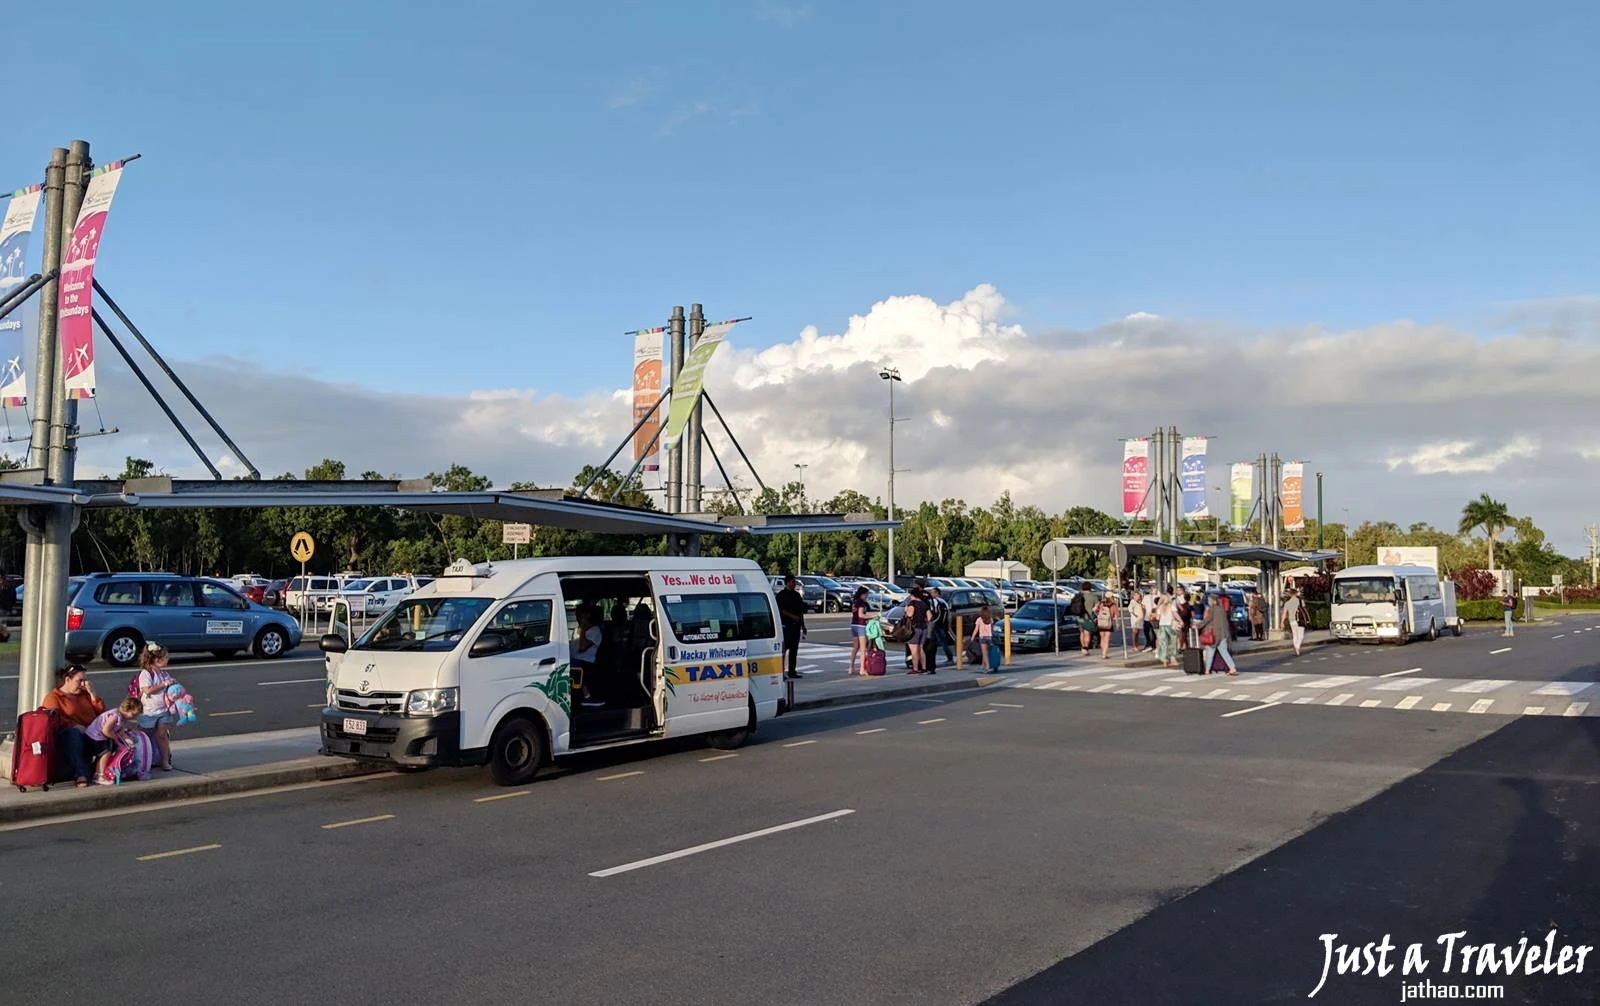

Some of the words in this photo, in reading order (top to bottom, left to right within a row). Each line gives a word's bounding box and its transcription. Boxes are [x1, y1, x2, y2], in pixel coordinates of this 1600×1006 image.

[451, 565, 464, 573] TAXI
[708, 574, 721, 585] do
[680, 649, 707, 661] Mackay
[708, 645, 748, 659] Whitsunday
[364, 663, 376, 673] 67
[685, 662, 743, 682] TAXI
